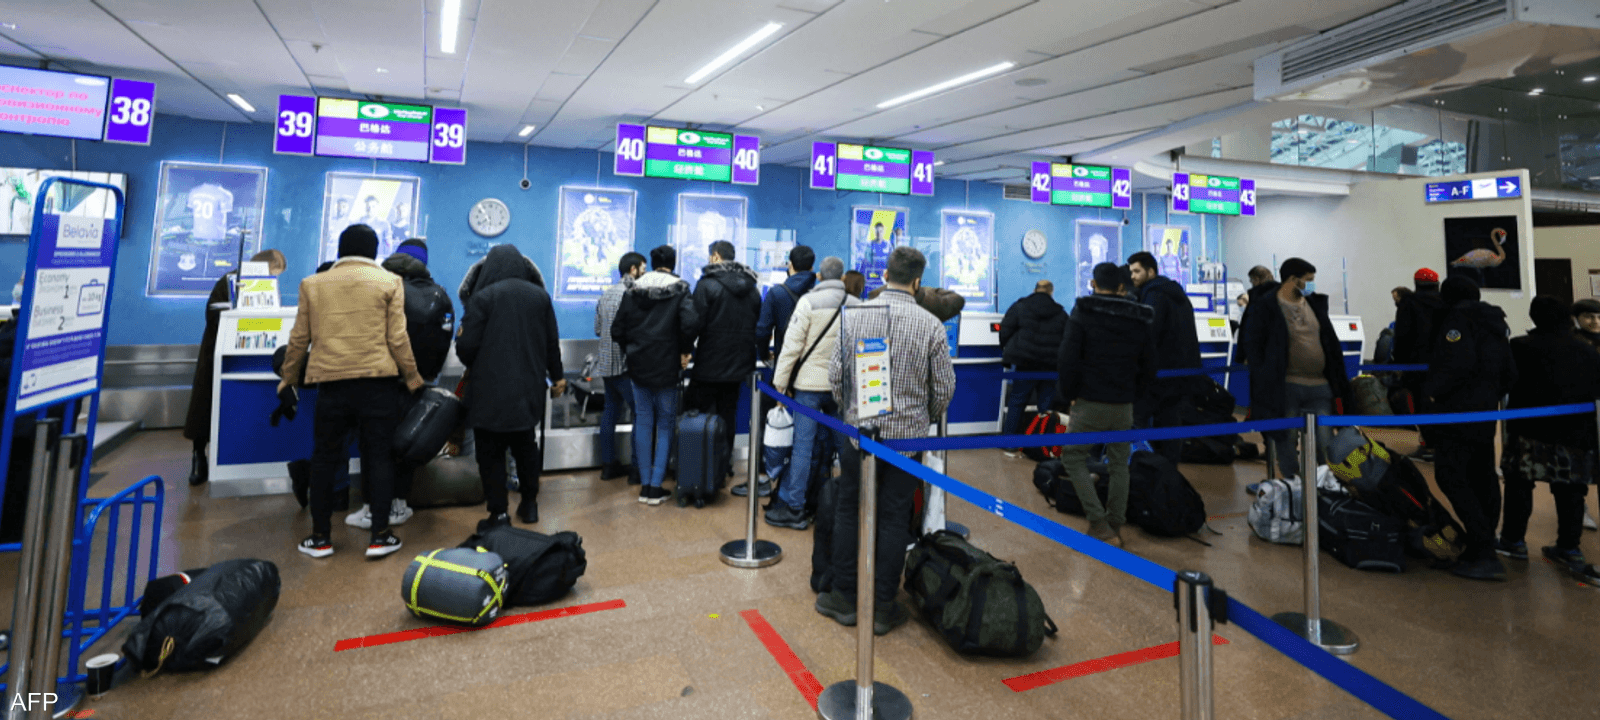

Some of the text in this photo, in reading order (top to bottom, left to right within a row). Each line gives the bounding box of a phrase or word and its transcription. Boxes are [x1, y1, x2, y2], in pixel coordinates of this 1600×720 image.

[0, 84, 64, 99] спектор
[111, 96, 151, 126] 38
[278, 110, 313, 137] 39
[434, 122, 464, 148] 39
[617, 138, 644, 161] 40
[734, 148, 758, 170] 40
[814, 155, 834, 176] 41
[914, 163, 932, 183] 41
[1032, 173, 1050, 191] 42
[1112, 179, 1130, 197] 42
[1173, 183, 1189, 200] 43
[1451, 185, 1469, 196] A-F
[1240, 189, 1256, 206] 43
[192, 201, 213, 219] 20
[63, 223, 99, 239] Belavia
[39, 271, 70, 285] Economy
[64, 285, 69, 299] 1
[58, 316, 65, 331] 2
